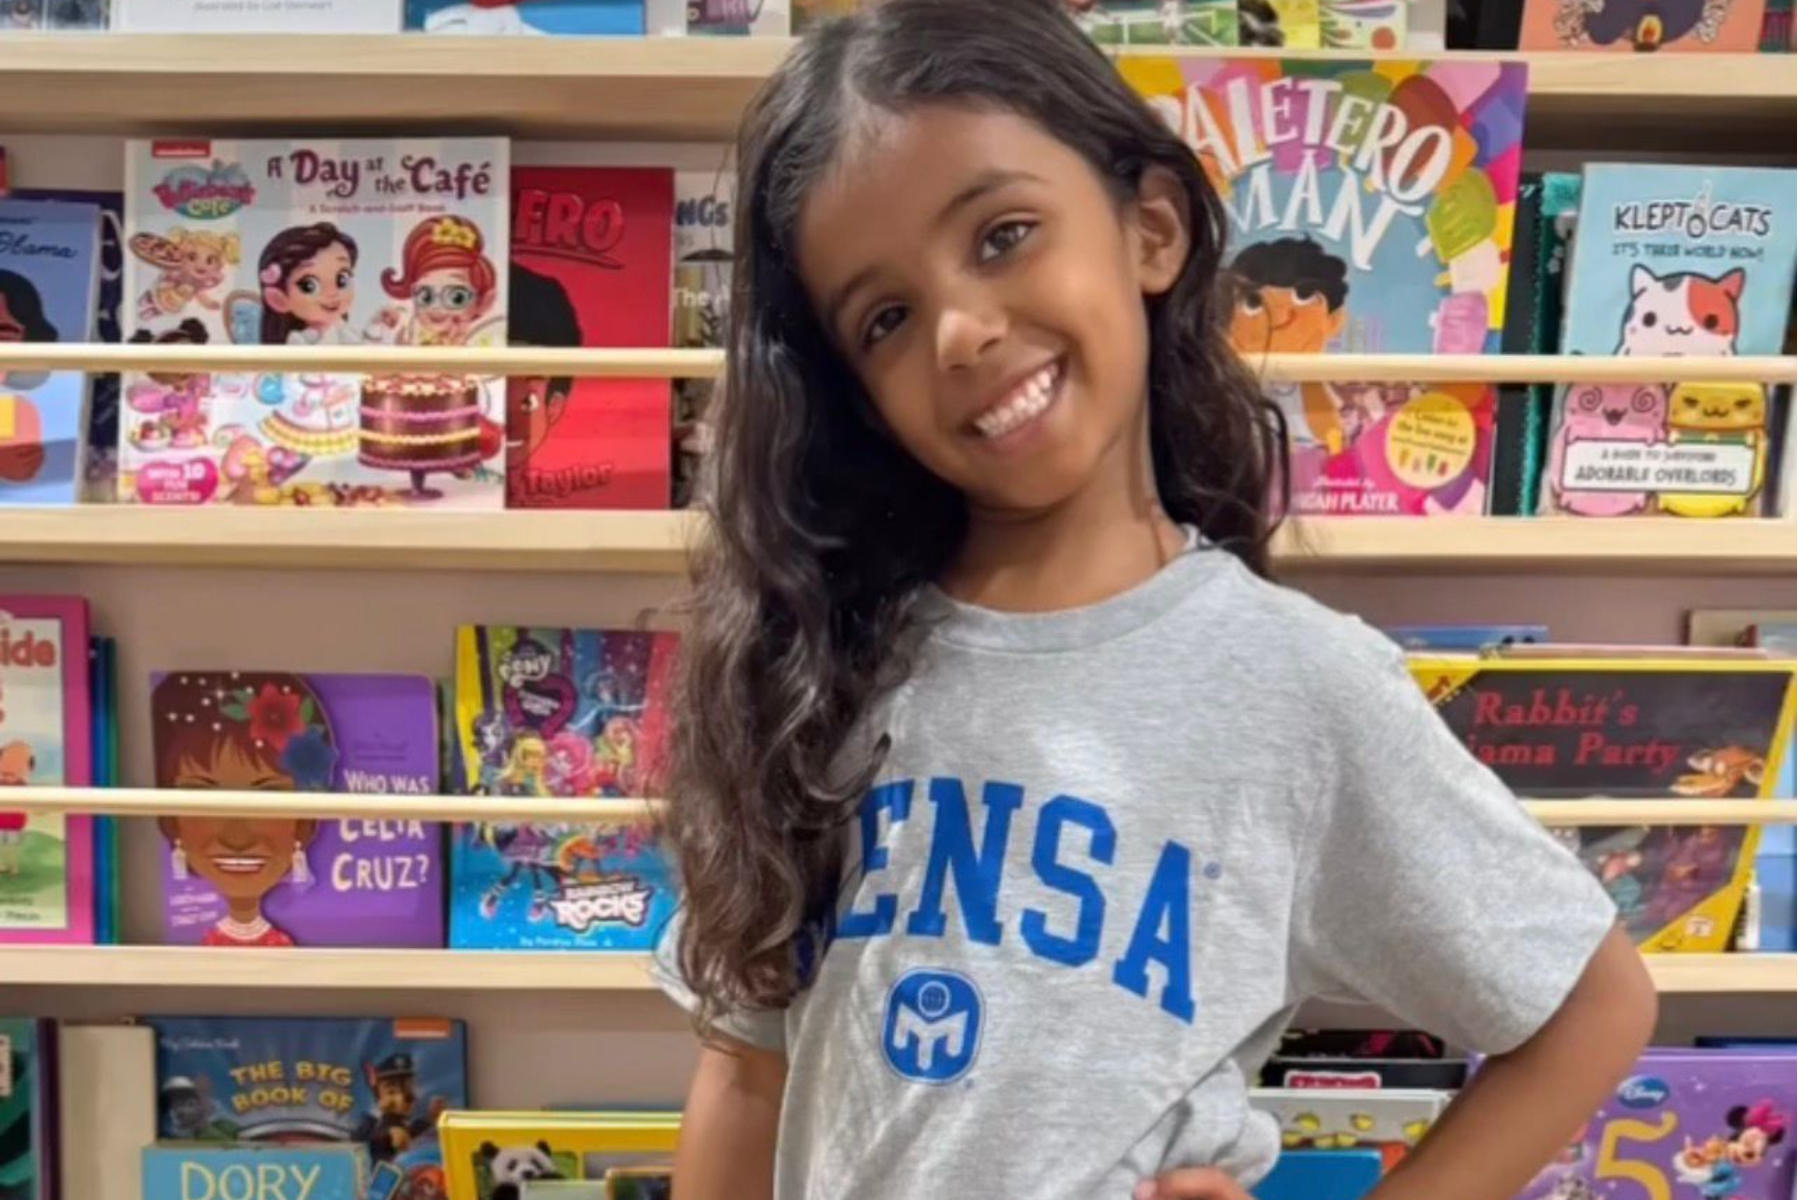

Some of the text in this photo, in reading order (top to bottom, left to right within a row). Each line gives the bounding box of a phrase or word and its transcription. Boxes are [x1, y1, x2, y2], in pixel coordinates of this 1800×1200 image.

[267, 148, 491, 201] A Day at the Café
[1613, 201, 1772, 239] KLEPTOCATS
[184, 462, 206, 480] 10
[524, 461, 614, 498] Taylor
[1574, 465, 1738, 487] ADORABLE OVERLORDS
[1474, 688, 1639, 727] Rabbit's
[1574, 731, 1681, 775] Party
[343, 769, 430, 794] WHO WAS
[331, 853, 430, 892] CRUZ?
[803, 777, 1197, 1025] ENSA
[230, 1060, 353, 1086] THE BIG
[230, 1087, 355, 1114] BOOK OF
[1595, 1111, 1678, 1200] 5
[181, 1161, 321, 1200] DORY
